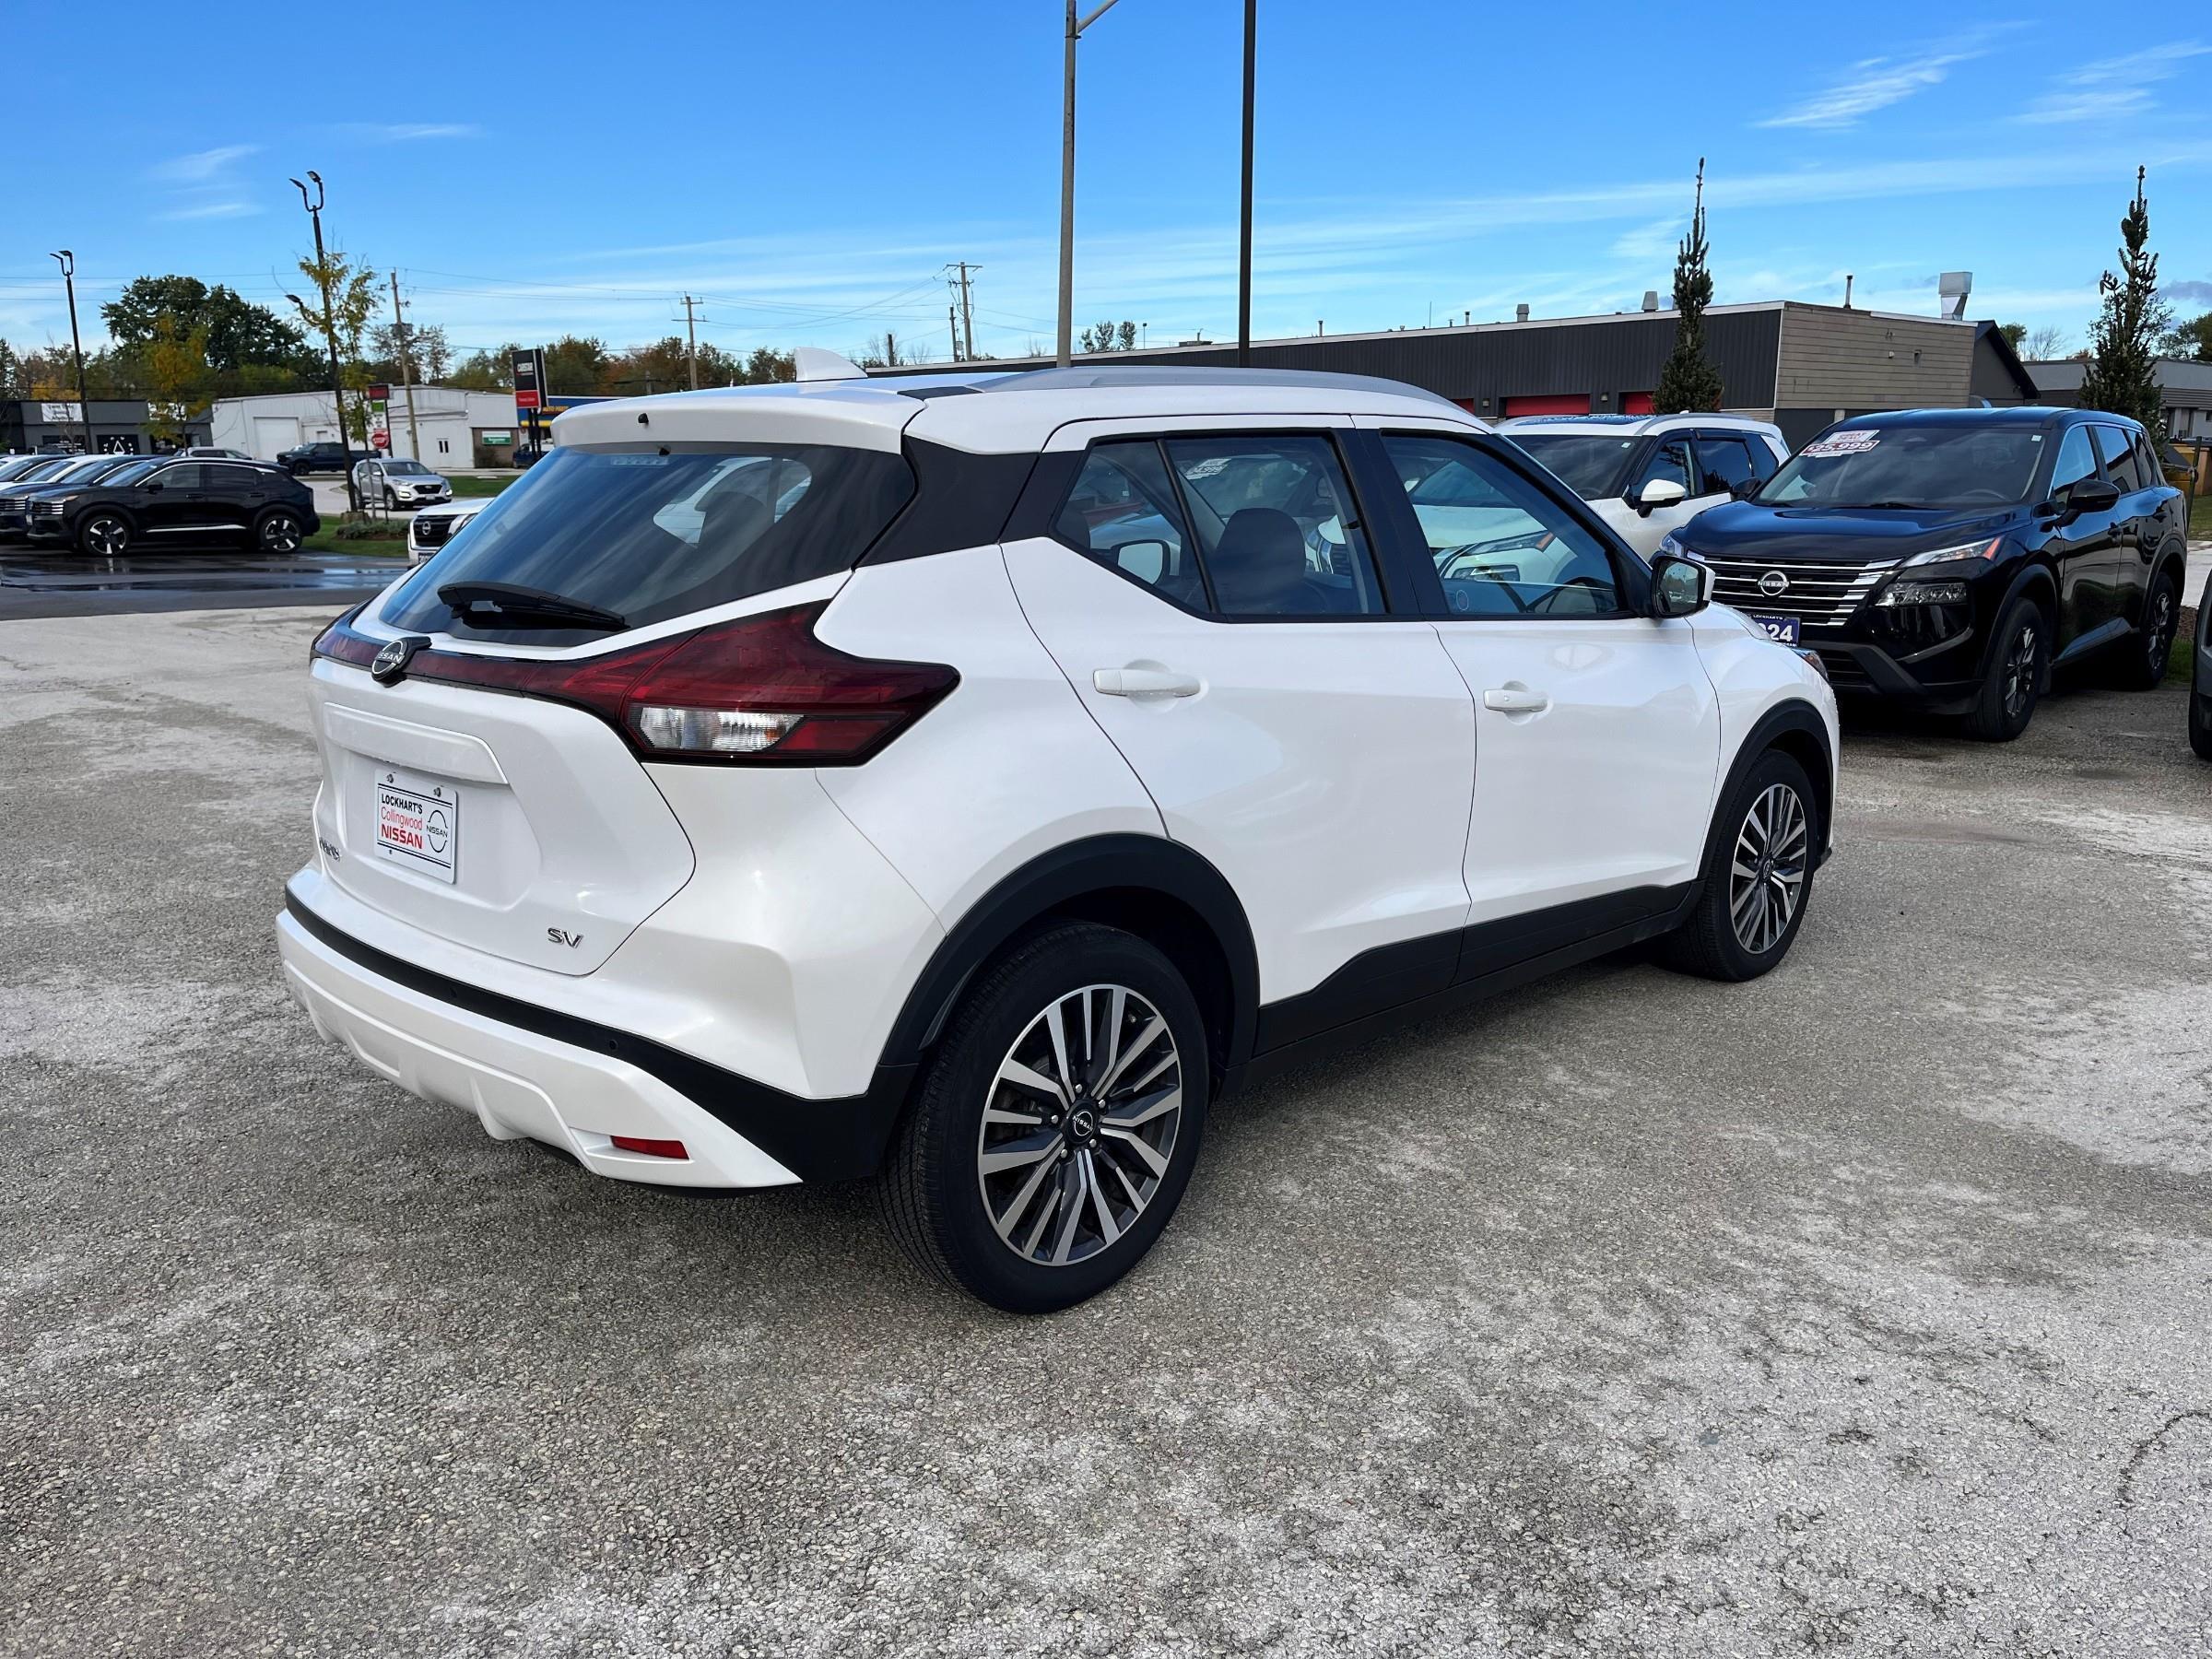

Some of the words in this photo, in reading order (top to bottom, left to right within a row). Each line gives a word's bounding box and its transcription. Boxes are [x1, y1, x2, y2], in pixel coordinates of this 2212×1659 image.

[1758, 580, 1790, 588] NISSAN
[382, 794, 423, 815] LOCKHART'S
[381, 806, 423, 831] Collingwood
[381, 824, 423, 850] NISSAN
[426, 825, 448, 838] NISSAN
[547, 927, 583, 949] SV
